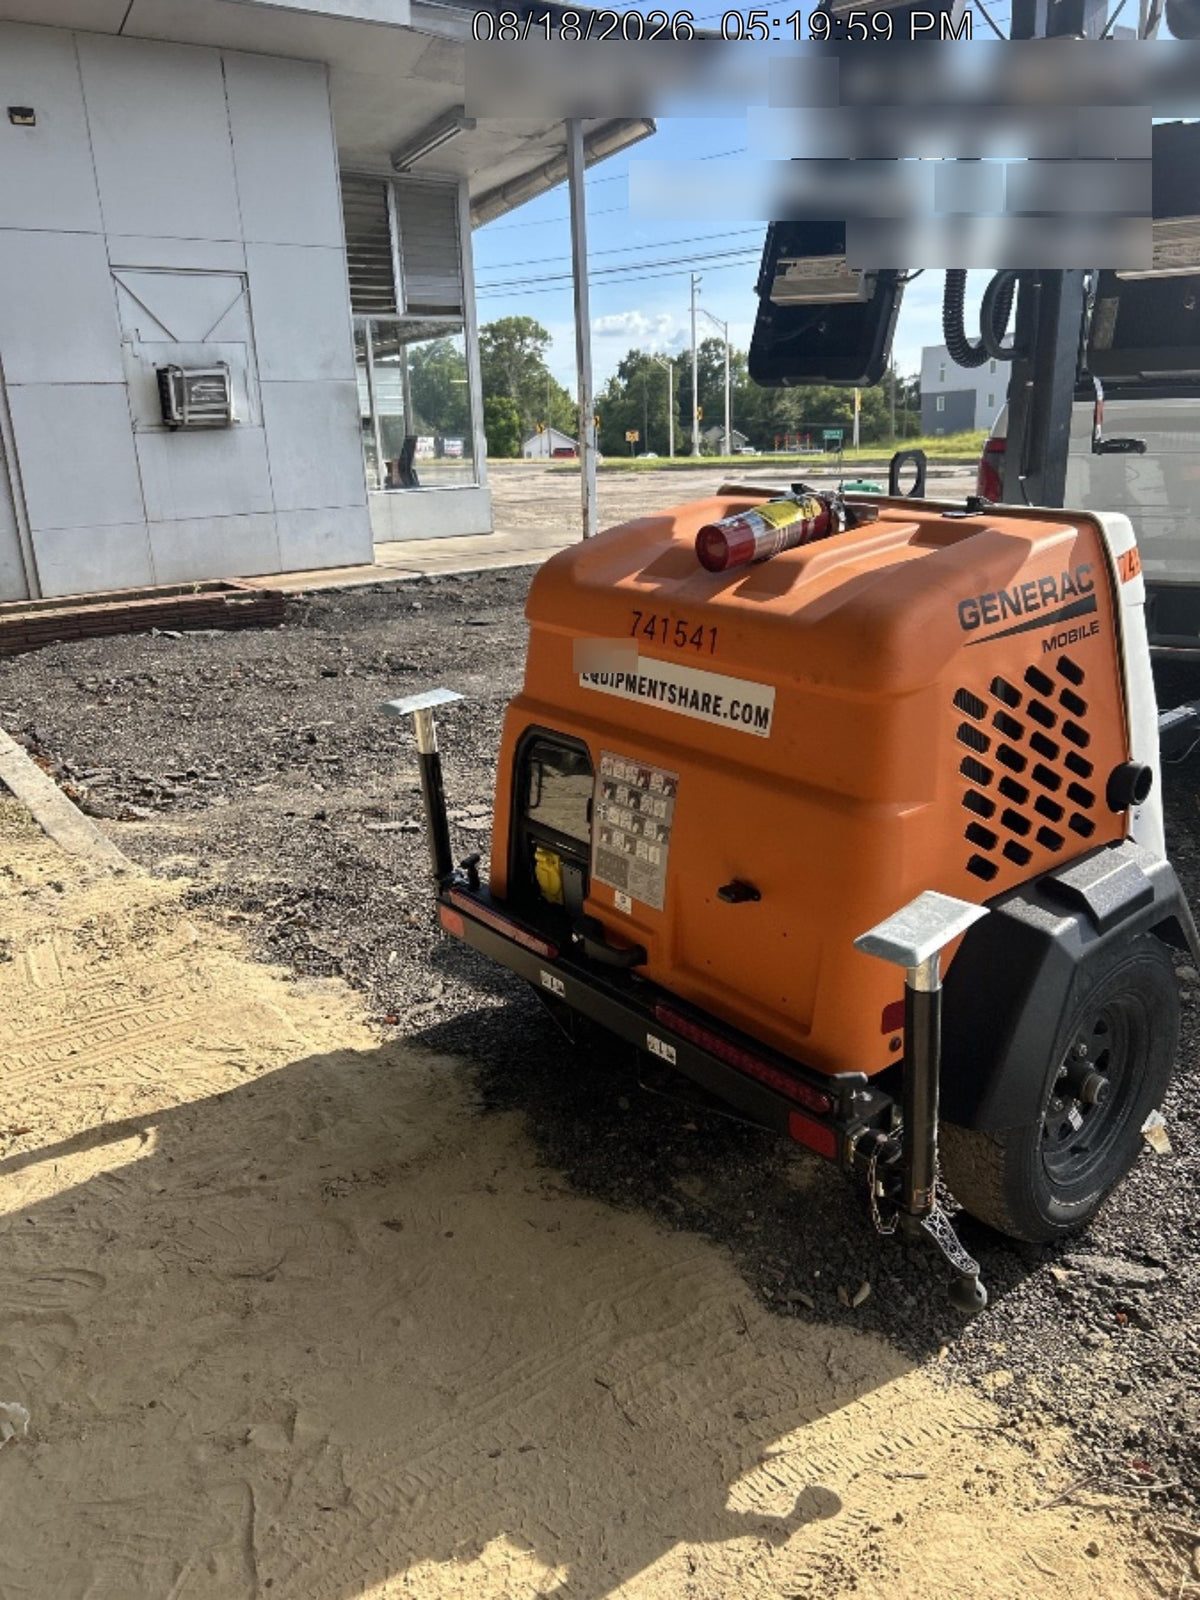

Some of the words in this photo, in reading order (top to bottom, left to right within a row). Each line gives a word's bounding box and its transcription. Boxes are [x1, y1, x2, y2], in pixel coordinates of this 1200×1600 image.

[958, 563, 1095, 632] GENERAC
[629, 610, 718, 655] 741541
[1042, 620, 1100, 654] MOBILE
